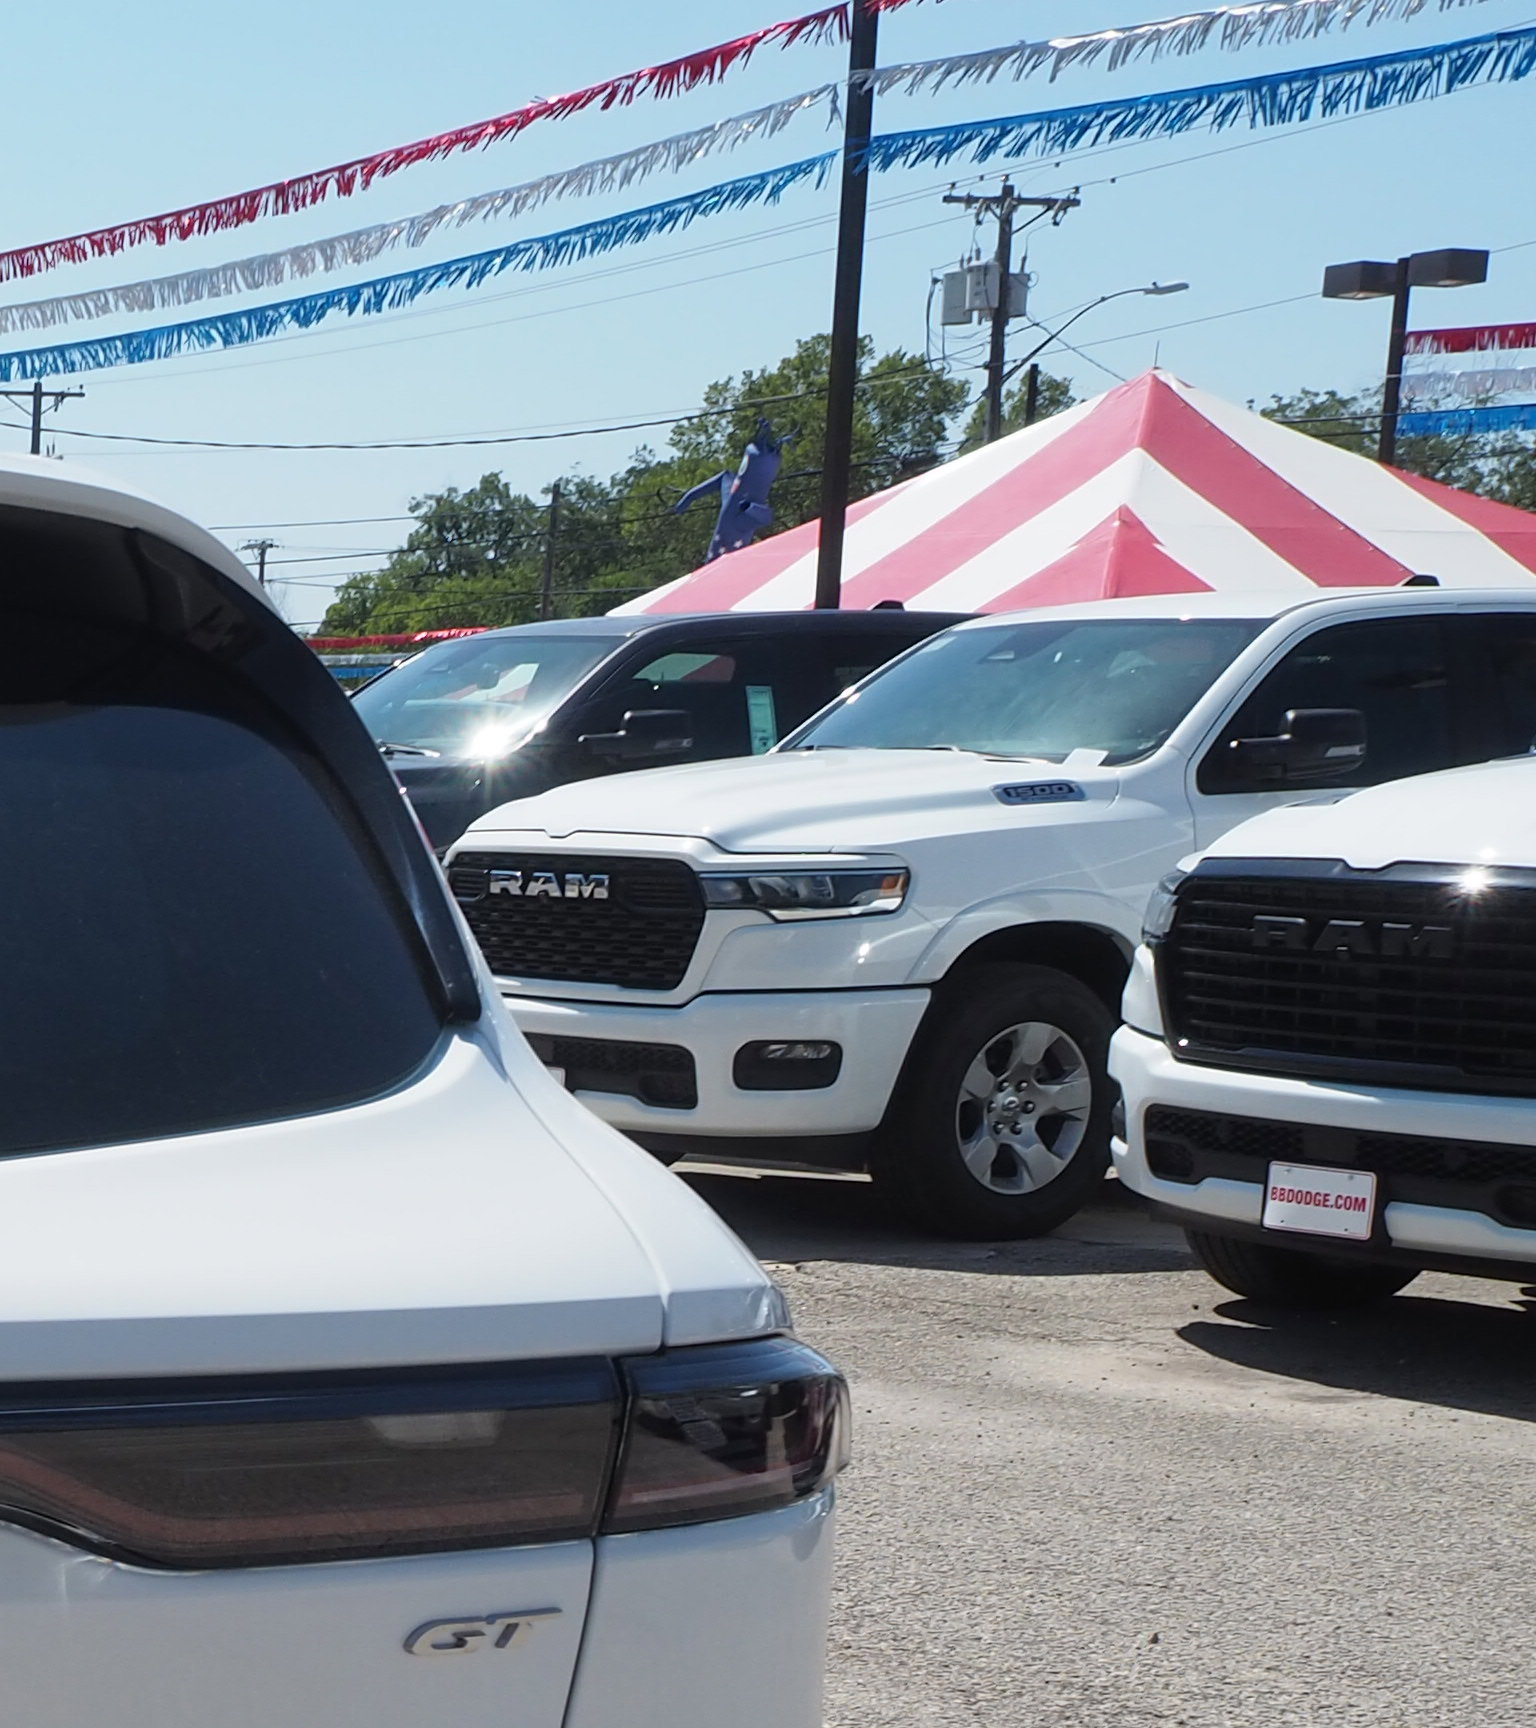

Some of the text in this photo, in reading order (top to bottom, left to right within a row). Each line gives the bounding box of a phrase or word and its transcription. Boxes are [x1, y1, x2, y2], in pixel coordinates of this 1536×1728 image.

[1006, 784, 1070, 798] 1500
[489, 870, 610, 899] RAM
[1252, 915, 1454, 958] RAM
[1270, 1186, 1367, 1212] BBDODGE.COM
[402, 1607, 563, 1656] GT
